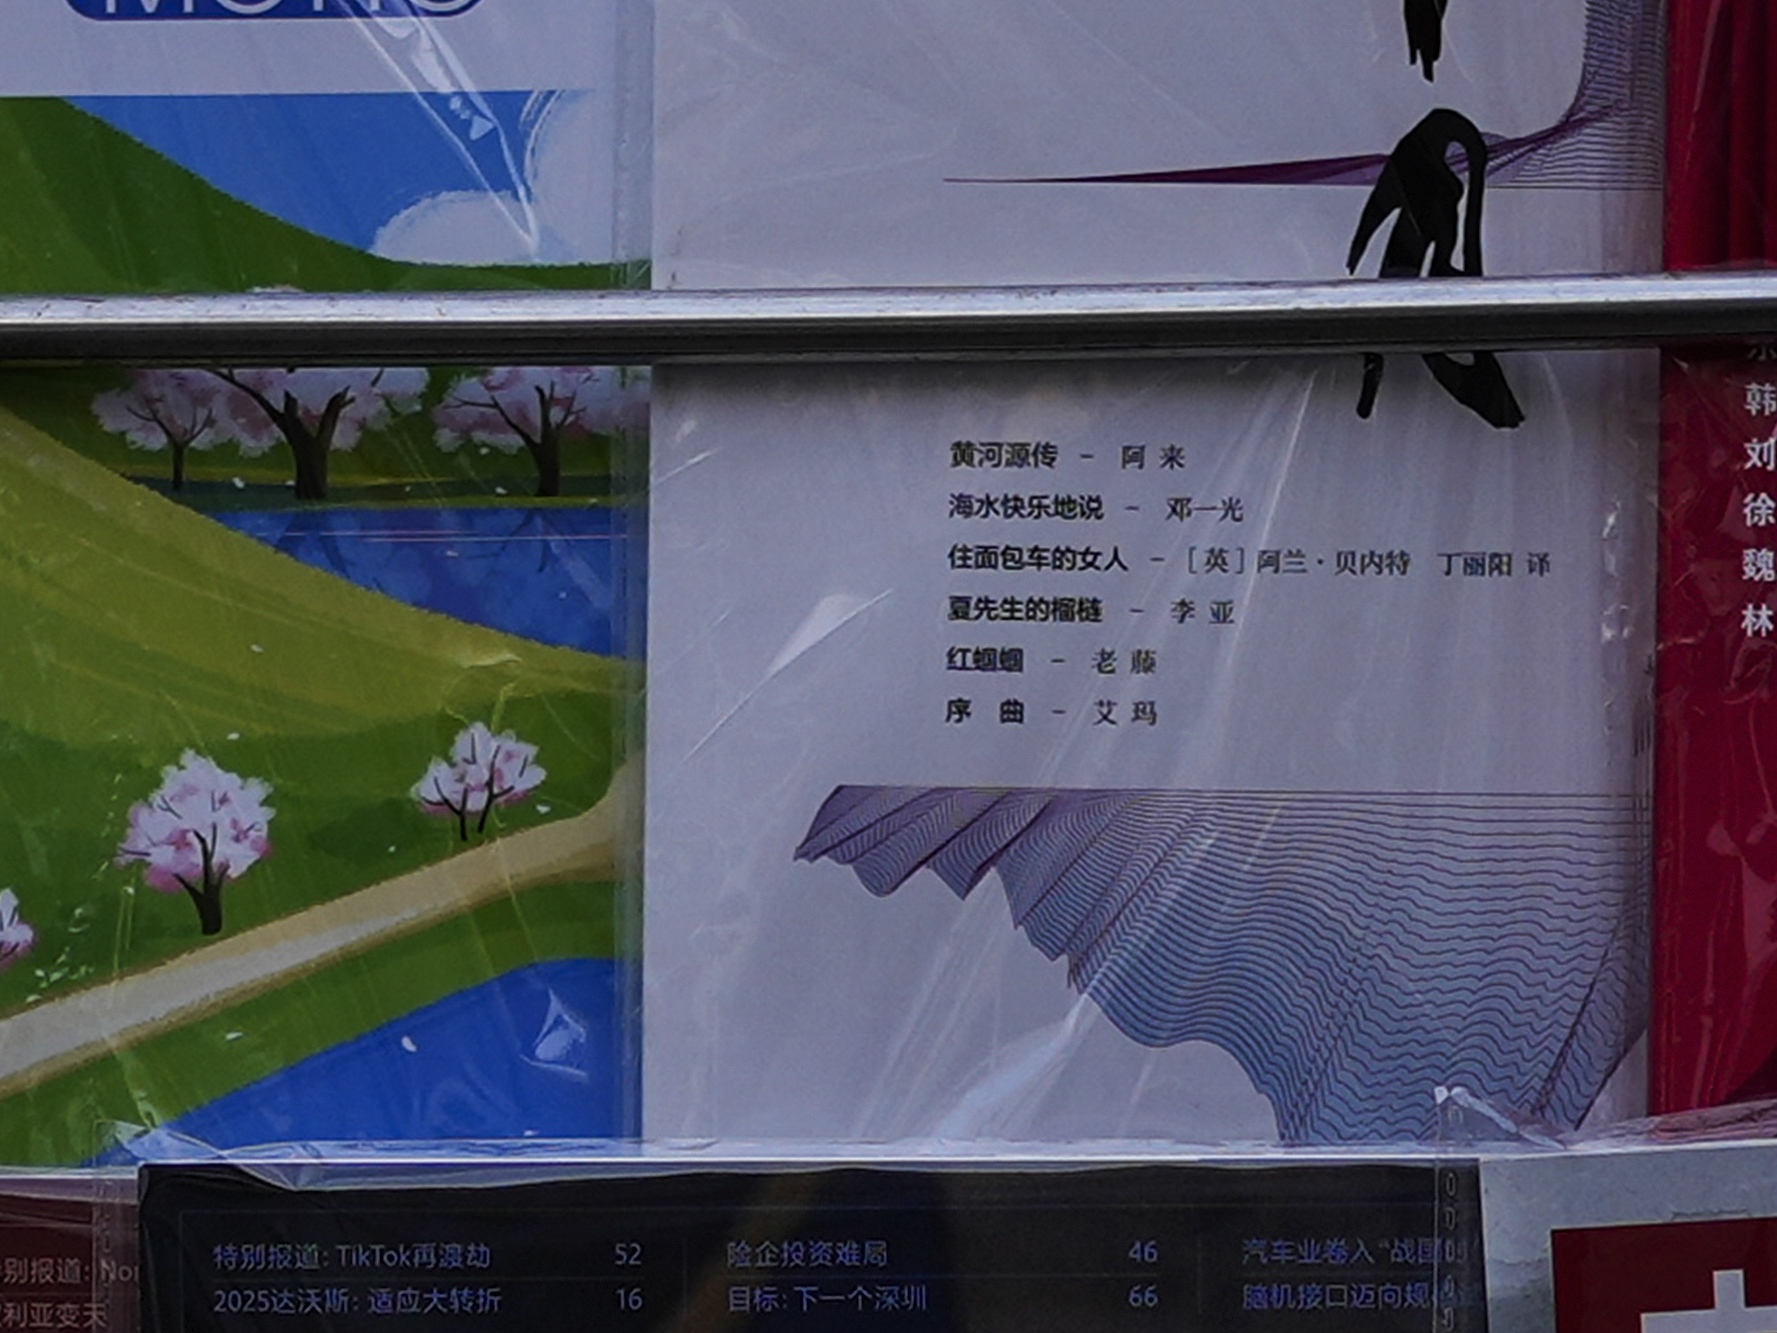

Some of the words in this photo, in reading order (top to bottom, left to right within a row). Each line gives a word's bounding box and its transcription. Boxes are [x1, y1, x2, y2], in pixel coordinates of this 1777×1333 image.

[950, 441, 1059, 469] 黄河源传
[949, 493, 1105, 520] 海水快乐地说
[1166, 497, 1245, 522] 邓一光
[948, 544, 1129, 571] 住面包车的女人
[614, 1243, 643, 1267] 52
[727, 1240, 889, 1269] 险企投资难局
[1128, 1240, 1159, 1263] 46
[615, 1289, 643, 1312] 16
[1128, 1285, 1159, 1308] 66
